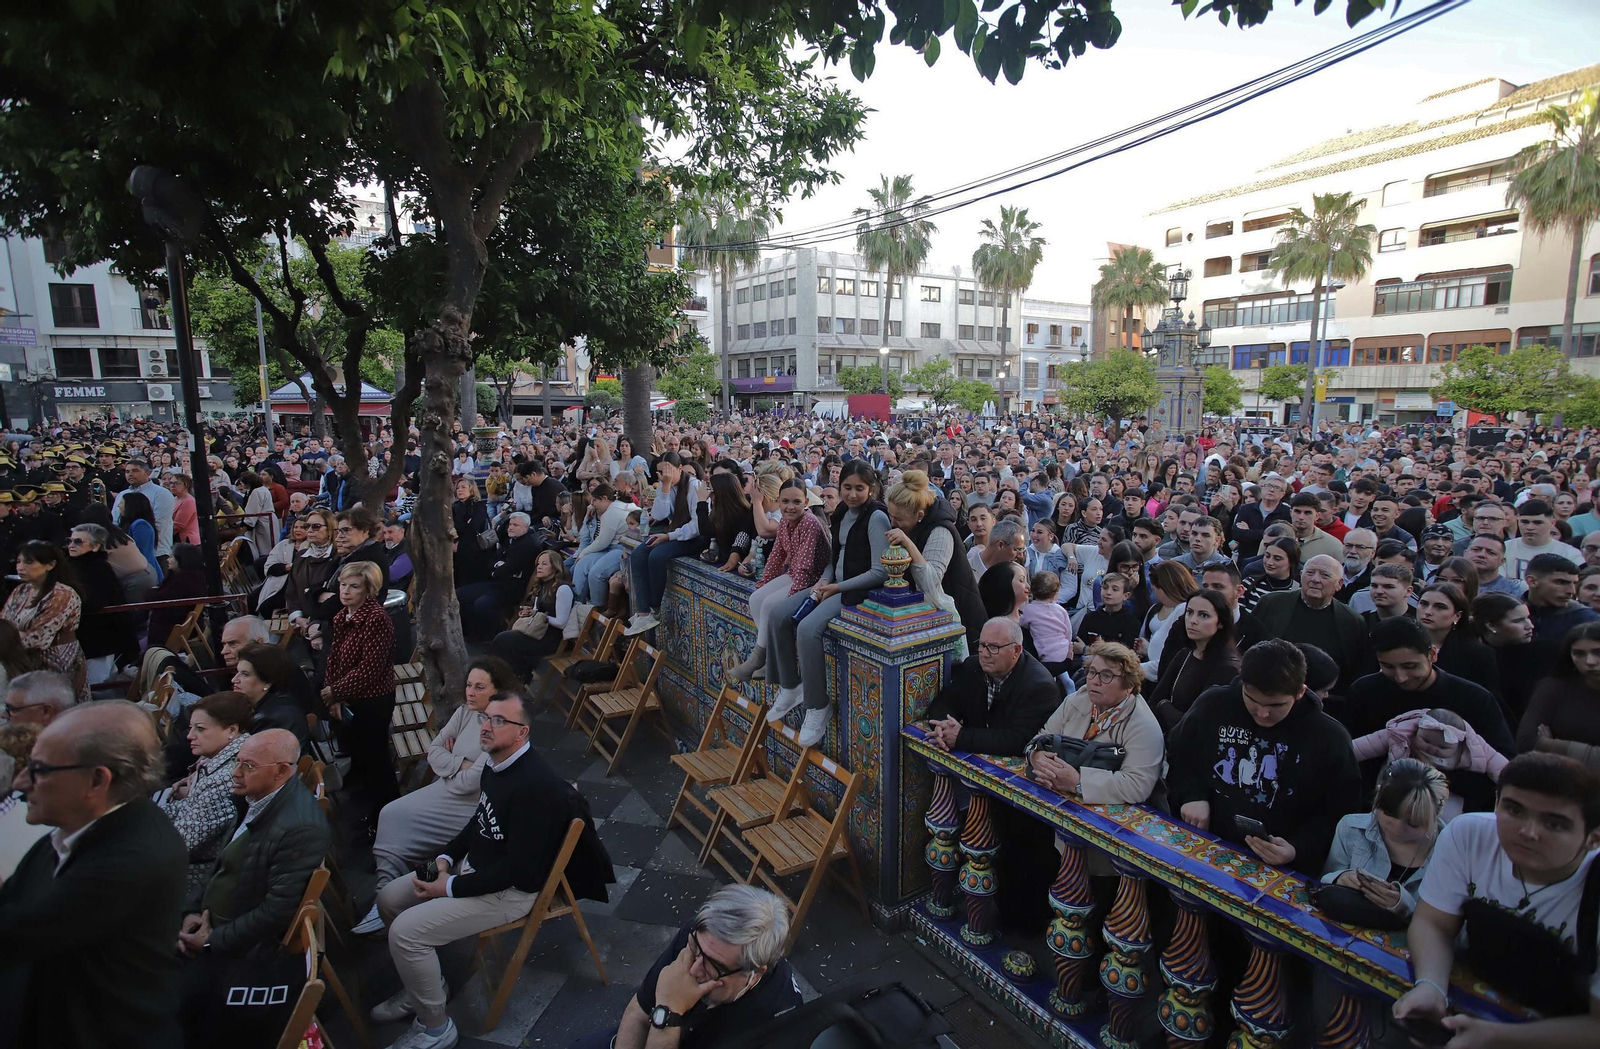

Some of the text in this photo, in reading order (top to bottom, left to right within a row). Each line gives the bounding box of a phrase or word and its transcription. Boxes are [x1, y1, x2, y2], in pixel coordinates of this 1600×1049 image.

[54, 386, 106, 398] FEMME
[1218, 725, 1249, 740] GUTS
[484, 802, 504, 841] ALPES
